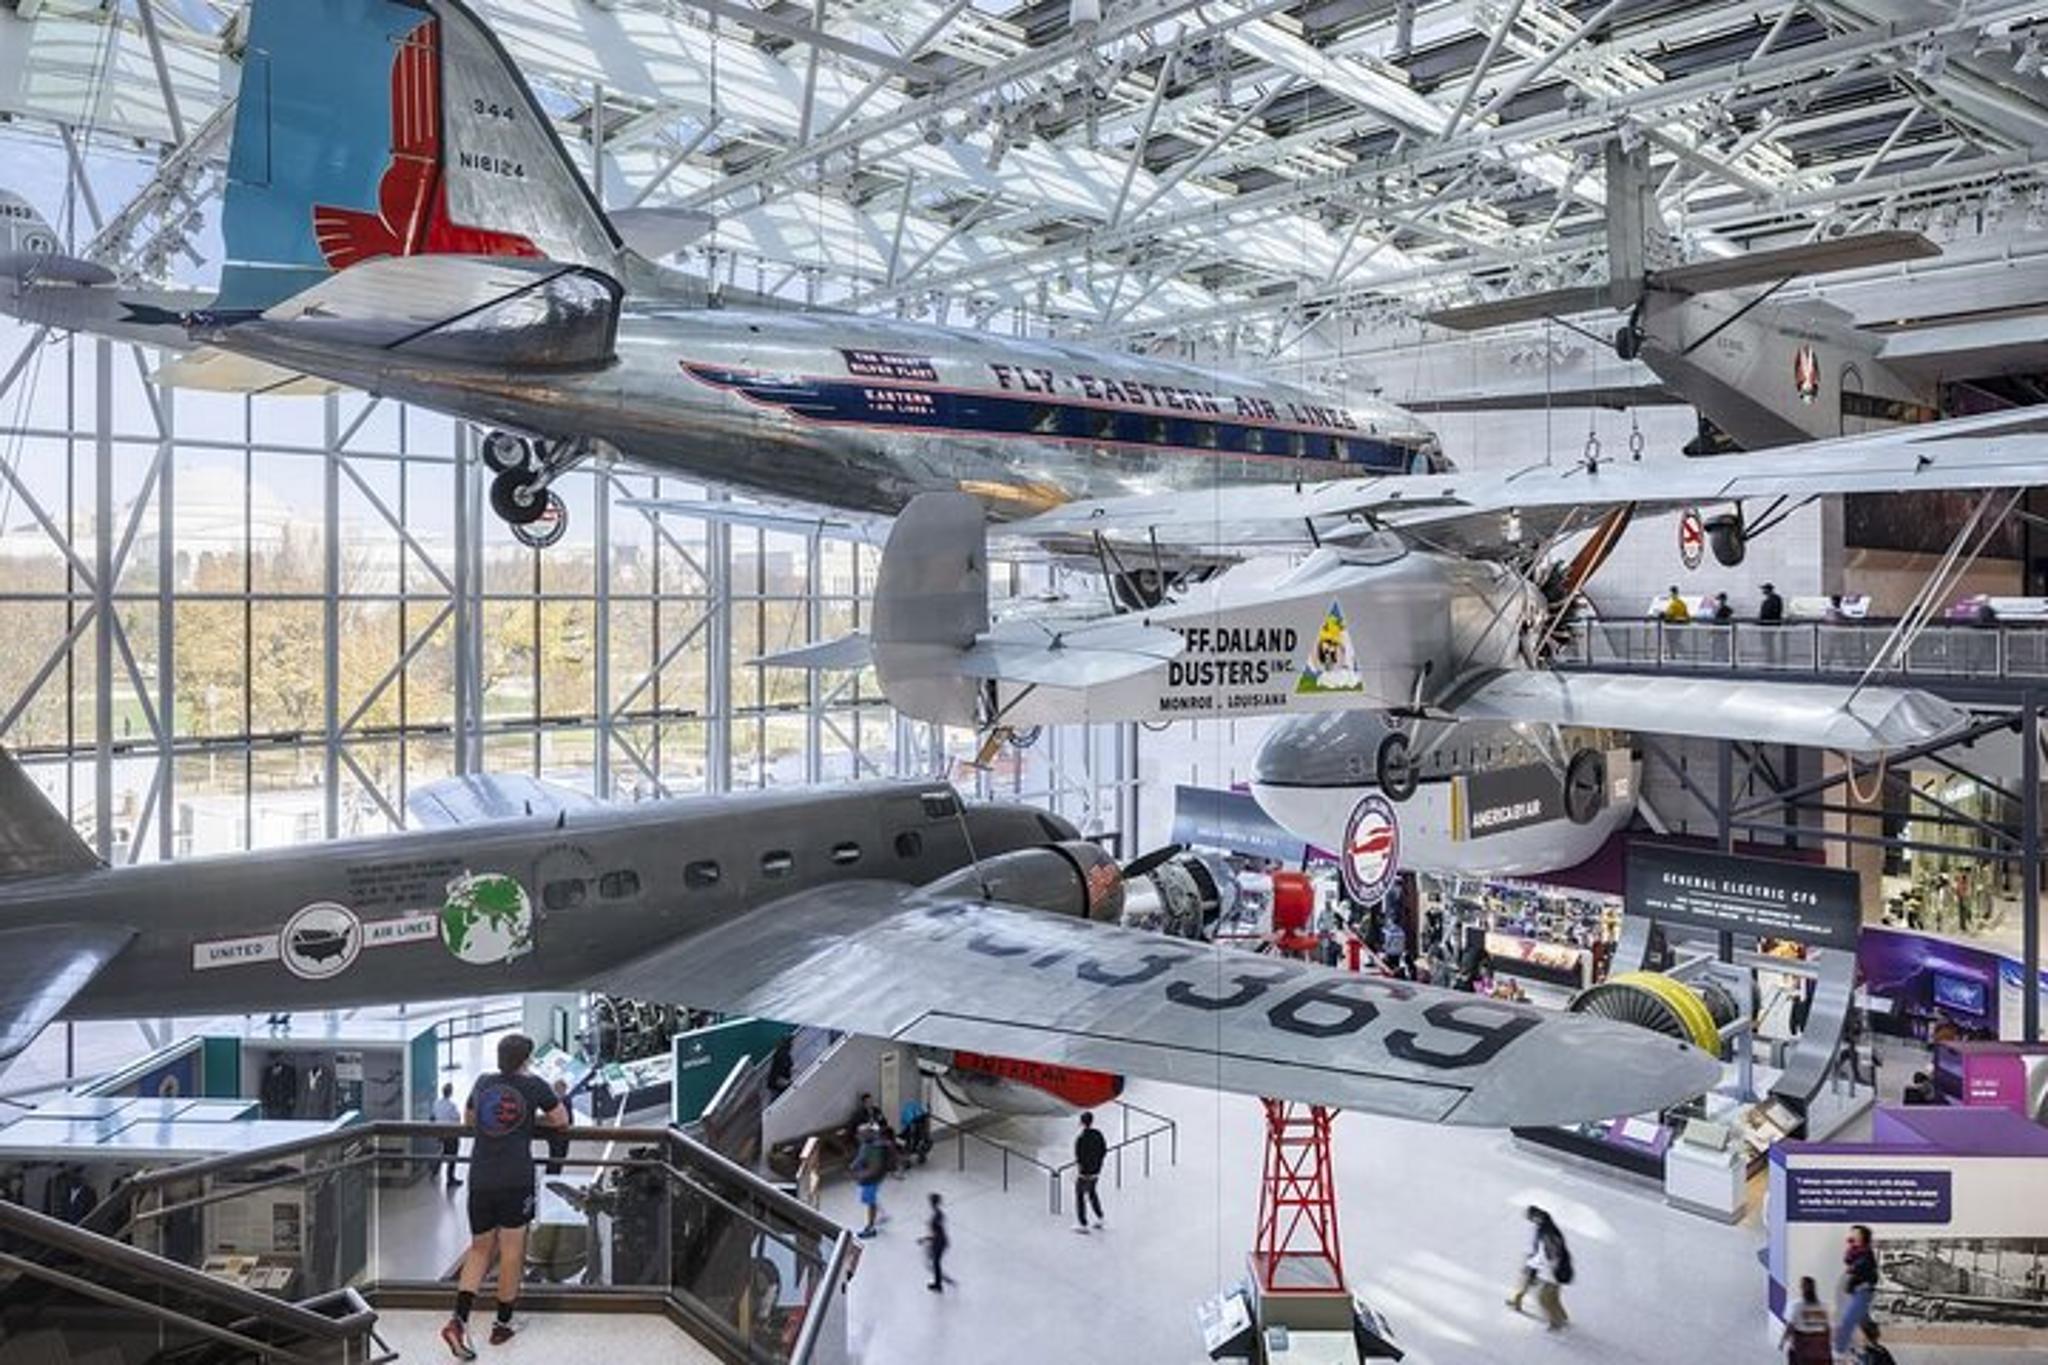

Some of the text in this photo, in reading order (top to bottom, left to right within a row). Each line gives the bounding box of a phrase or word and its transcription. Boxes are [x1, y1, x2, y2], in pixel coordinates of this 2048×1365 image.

[473, 99, 516, 120] 344
[460, 151, 525, 177] N18124
[989, 362, 1358, 431] FLY EASTERN AIR LINES
[1168, 659, 1270, 687] DUSTERS
[1160, 693, 1287, 711] MONROE LOUISIANA
[1662, 871, 1717, 892] GENERAL
[1722, 880, 1786, 901] ELECTRIC
[209, 919, 433, 961] UNITED AIR LINES
